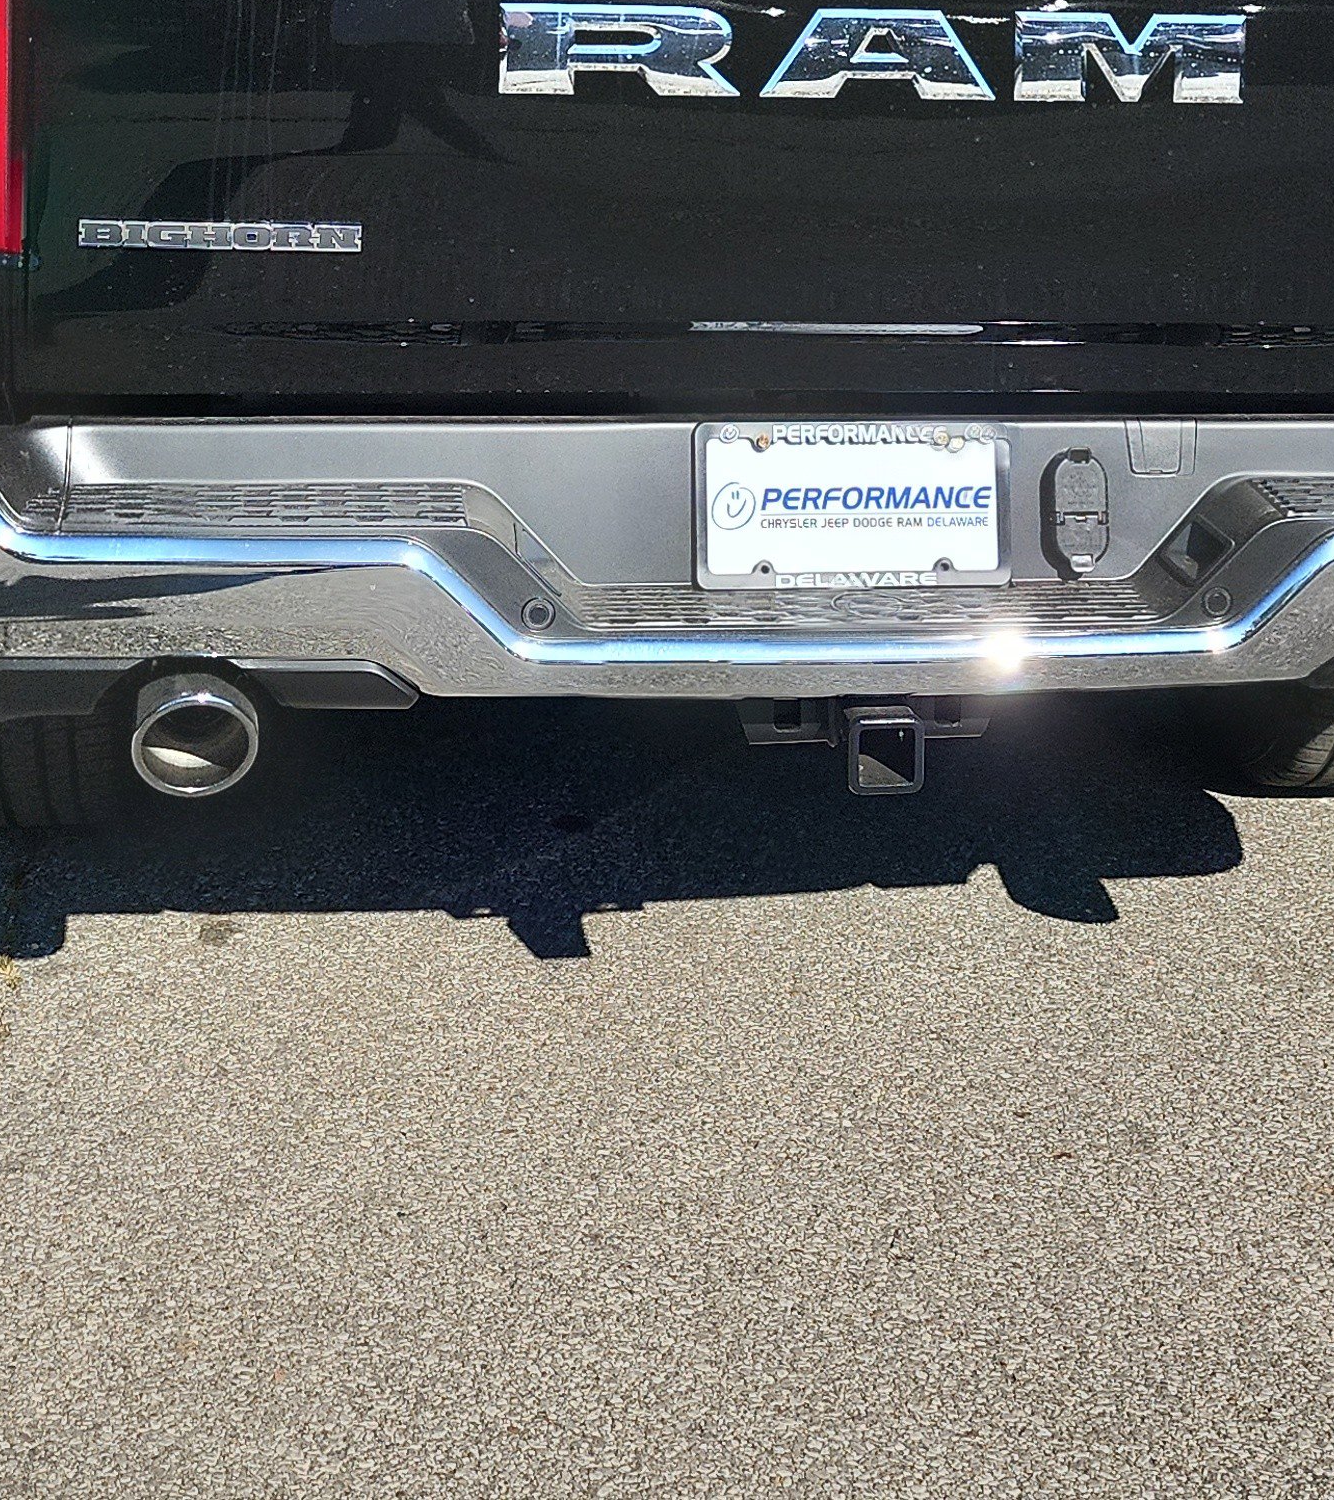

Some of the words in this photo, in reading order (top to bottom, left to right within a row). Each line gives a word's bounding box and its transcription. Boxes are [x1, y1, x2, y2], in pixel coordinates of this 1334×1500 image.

[499, 3, 1248, 104] RAM
[760, 486, 993, 511] PERFORMANCE
[760, 518, 818, 529] CHRYSLER
[820, 518, 850, 529] JEEP
[853, 517, 894, 528] DODGE
[896, 517, 923, 528] RAM
[927, 516, 989, 528] DELAWARE
[775, 572, 939, 588] DELAWARE
